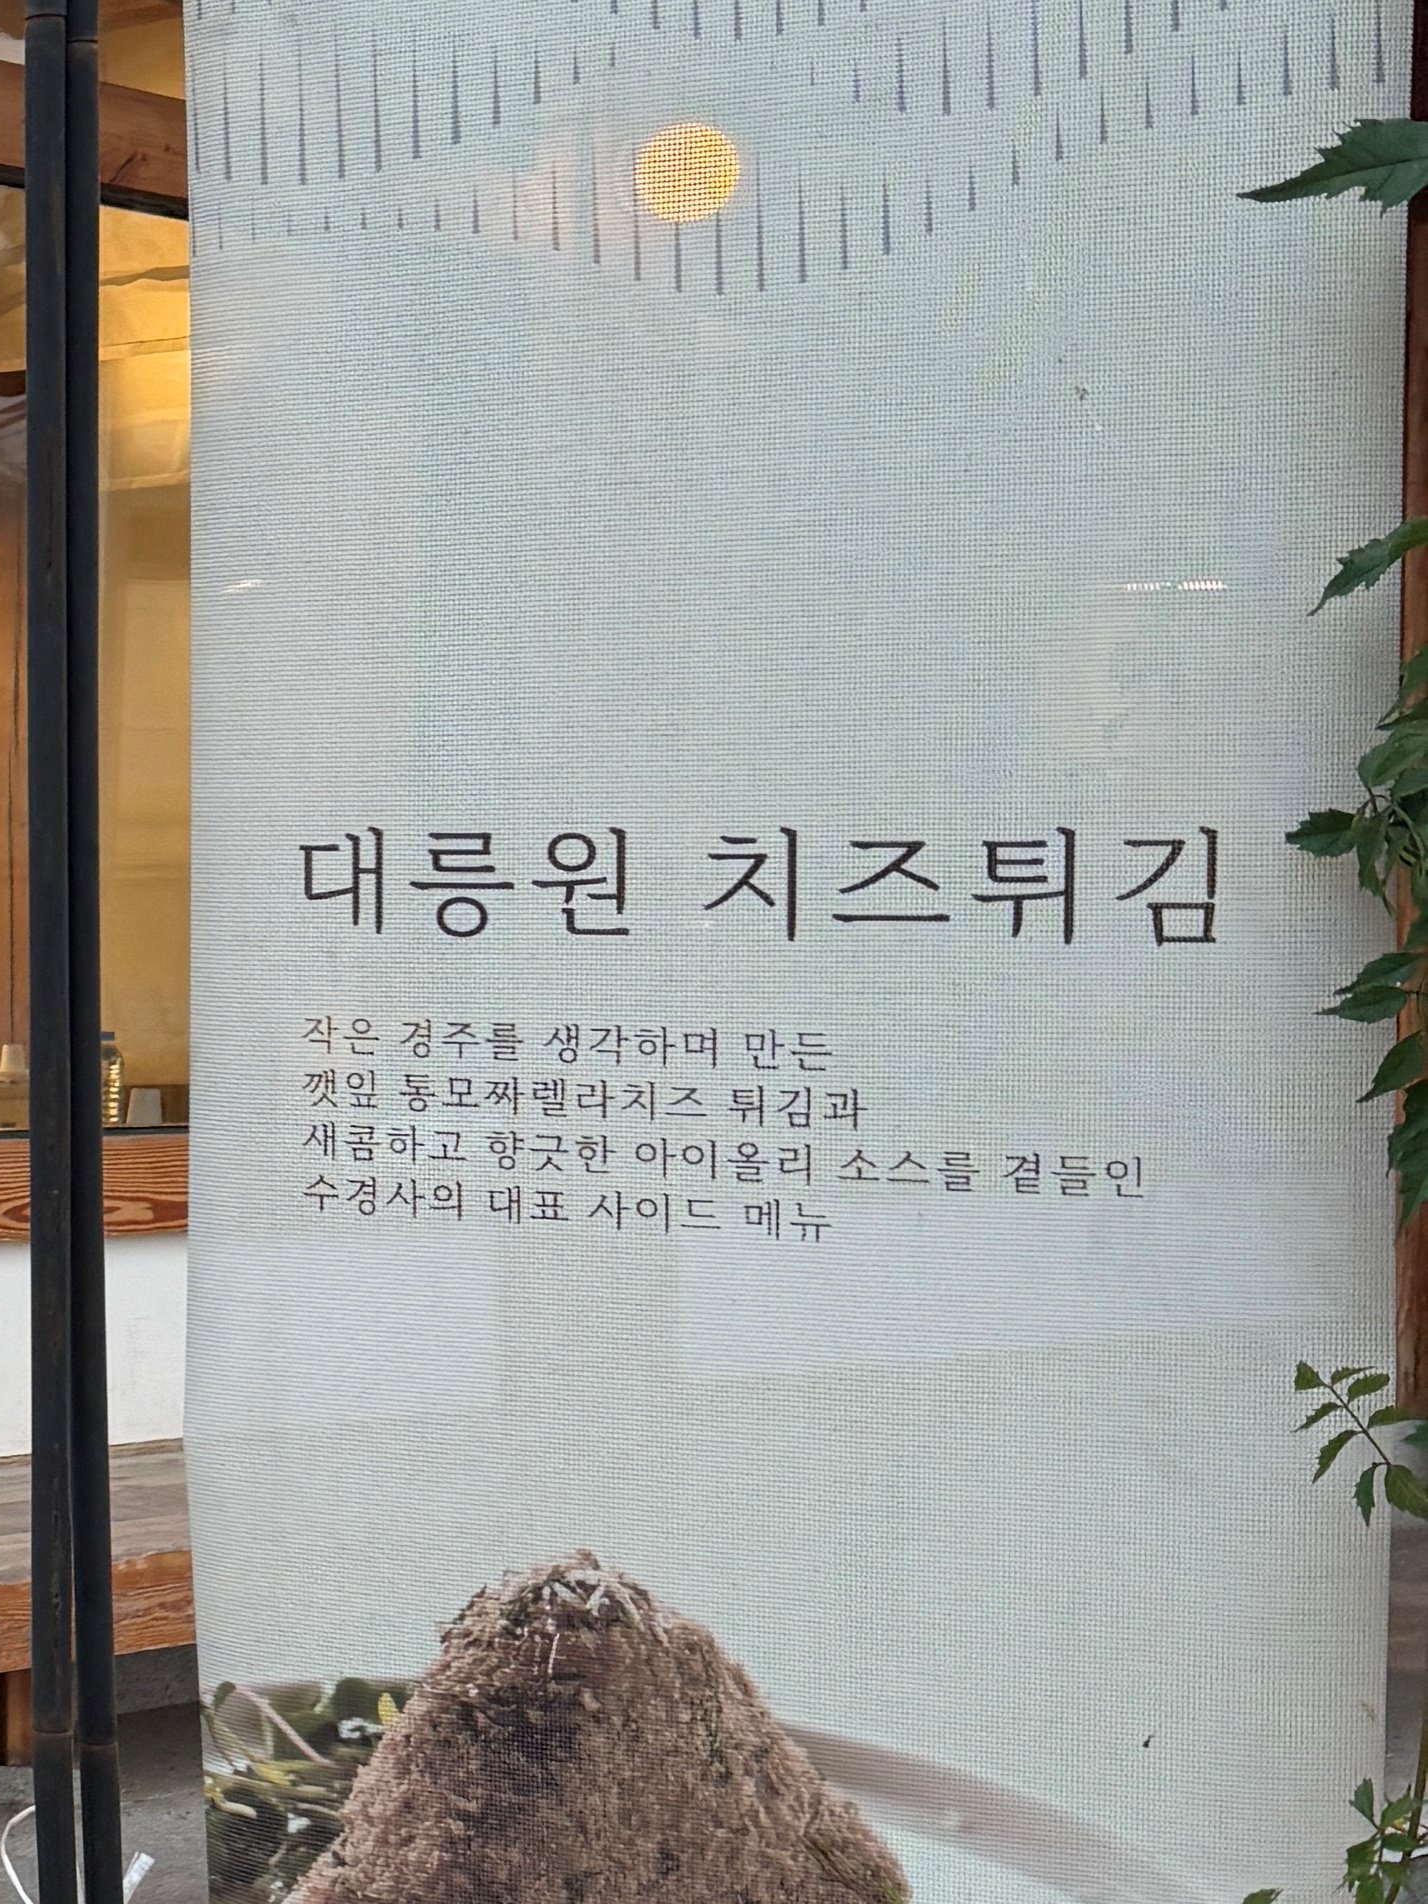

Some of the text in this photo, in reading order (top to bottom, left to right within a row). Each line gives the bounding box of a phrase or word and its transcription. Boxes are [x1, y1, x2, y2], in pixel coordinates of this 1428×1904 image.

[297, 825, 1220, 946] 대릉원 치즈튀김
[302, 1016, 833, 1072] 작은 경주를 생각하며 만든
[302, 1068, 869, 1131] 깻잎 통모짜렐라치즈 튀김과
[302, 1121, 1144, 1198] 새콤하고 향긋한 아이올리 소스를 곁들인
[303, 1174, 833, 1243] 수경사의 대표 사이드 메뉴
